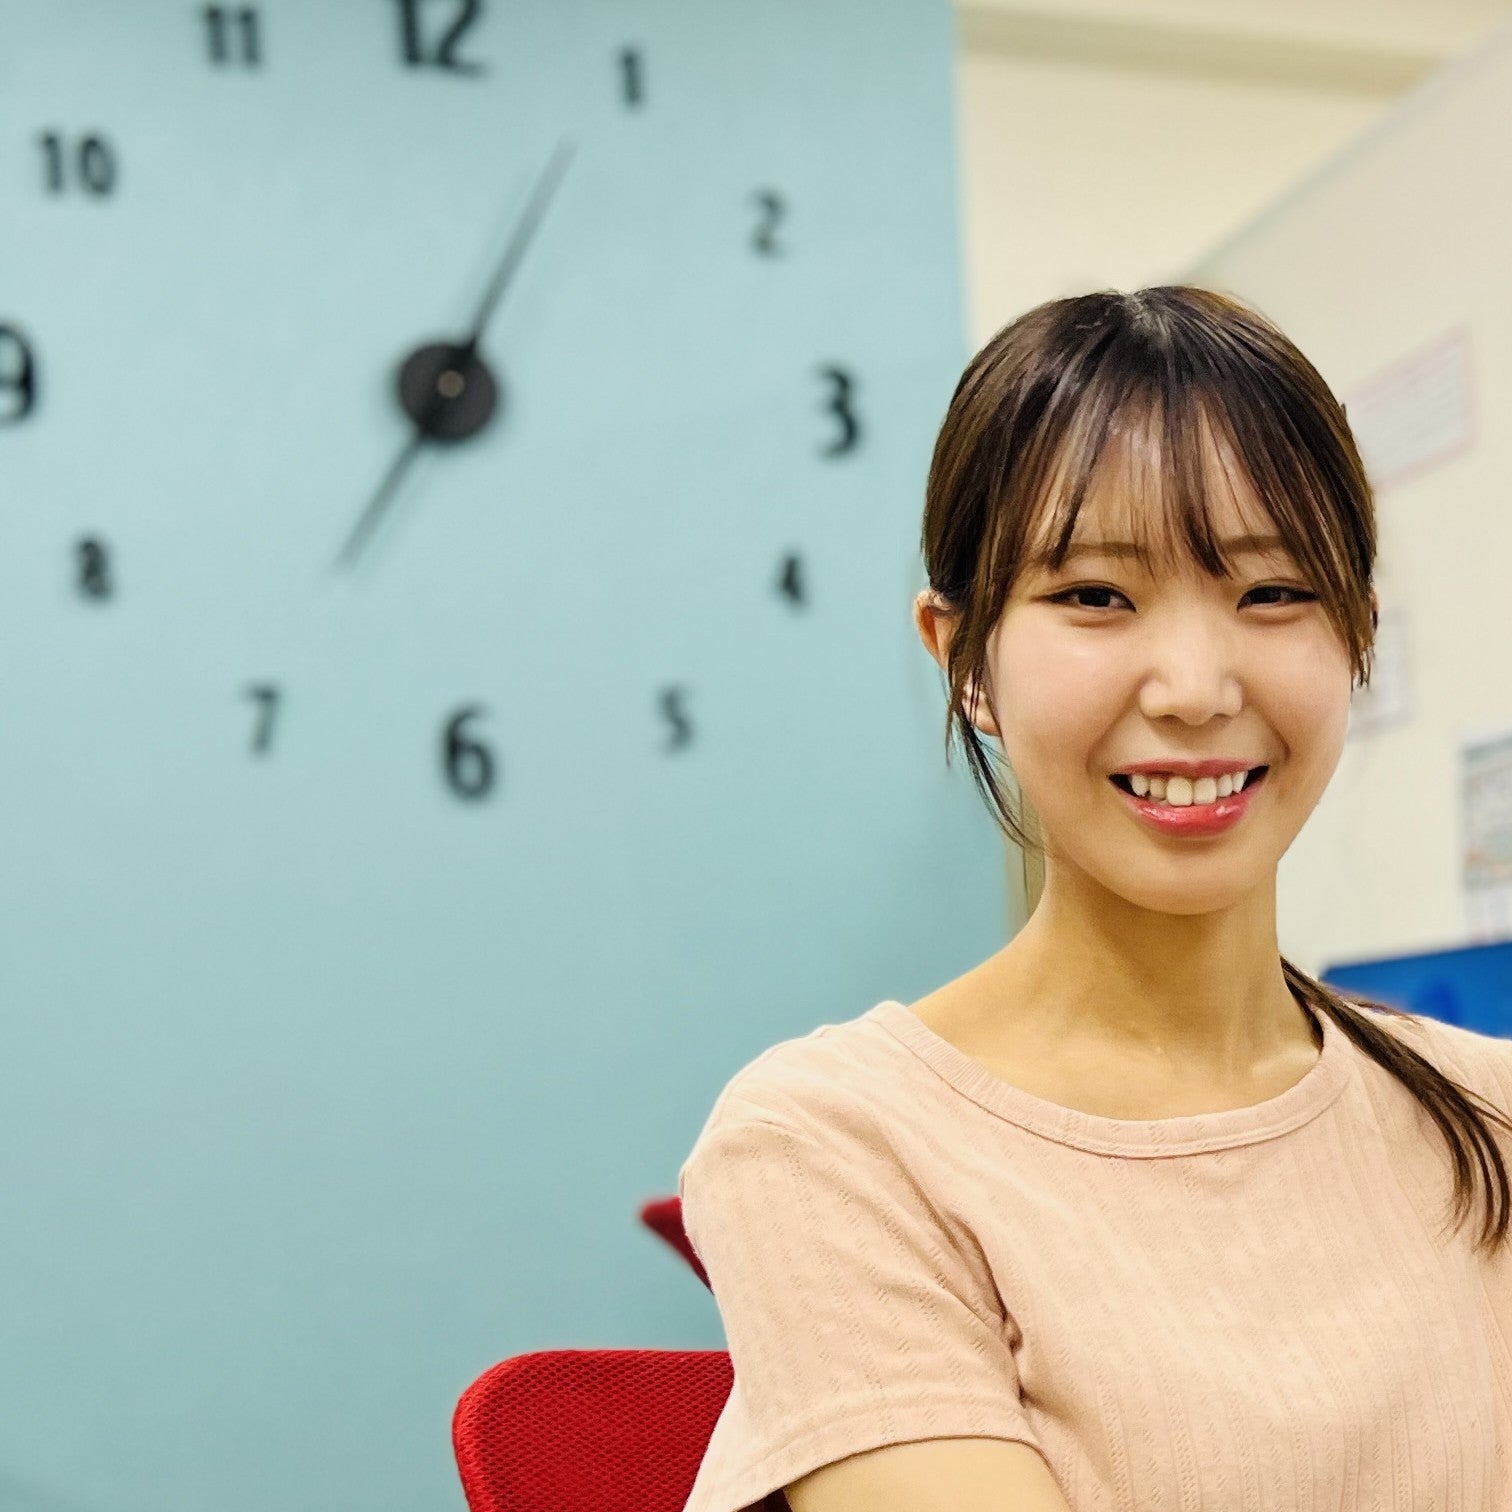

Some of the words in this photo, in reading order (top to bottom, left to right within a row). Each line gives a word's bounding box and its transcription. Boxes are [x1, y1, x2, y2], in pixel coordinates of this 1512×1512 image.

[198, 3, 262, 69] 11
[393, 0, 487, 77] 12
[616, 45, 645, 109] 1
[39, 130, 117, 199] 10
[750, 189, 786, 258] 2
[0, 323, 39, 424] 9
[820, 366, 863, 459] 3
[74, 536, 114, 604] 8
[775, 549, 808, 610] 4
[247, 683, 282, 756] 7
[440, 704, 497, 802] 6
[657, 686, 695, 754] 5
